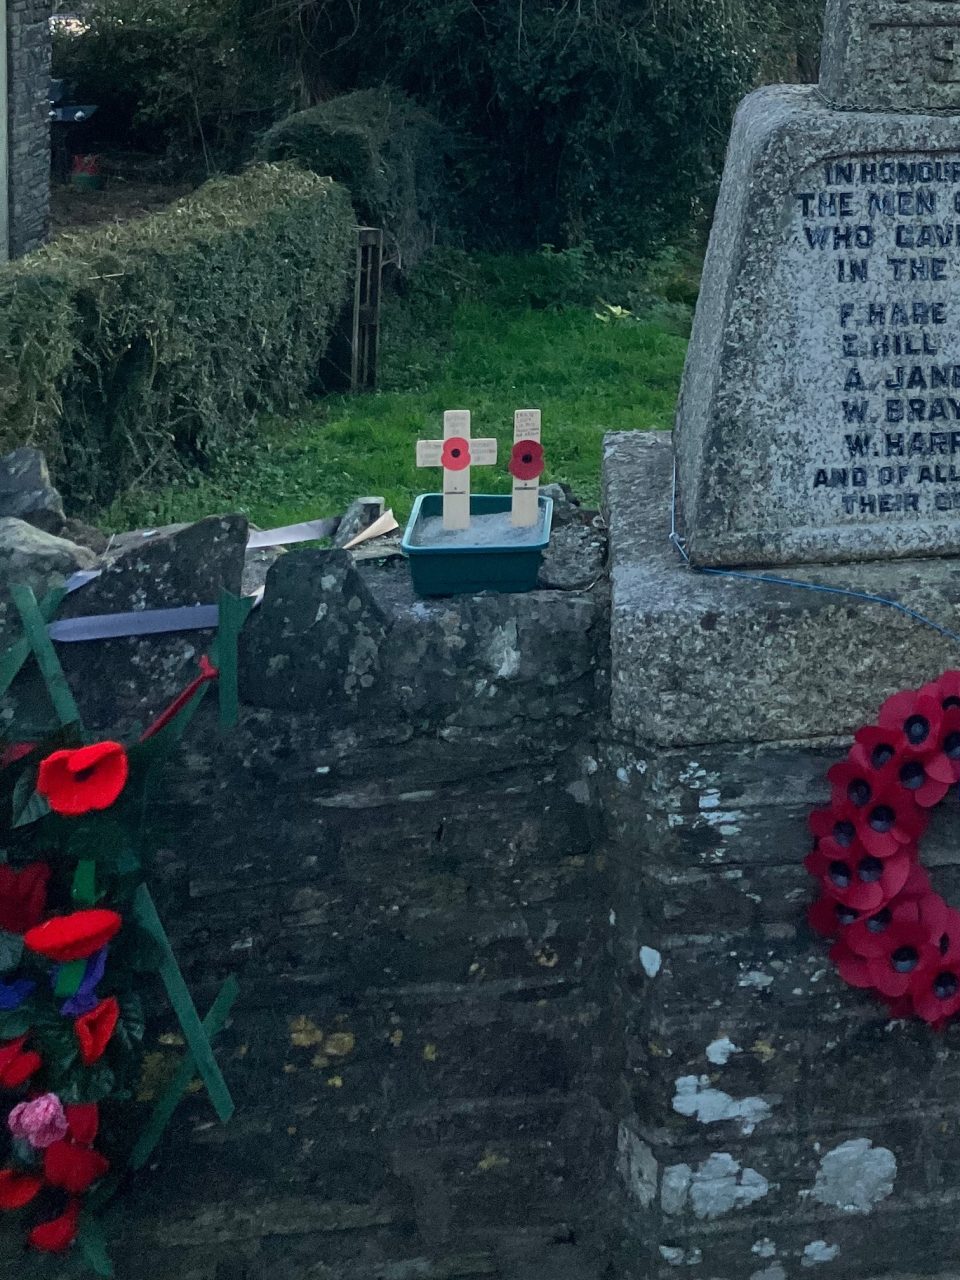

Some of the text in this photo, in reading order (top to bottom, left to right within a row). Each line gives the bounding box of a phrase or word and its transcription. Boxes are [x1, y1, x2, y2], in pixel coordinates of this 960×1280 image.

[825, 162, 853, 185] IN
[793, 192, 853, 217] THE
[868, 191, 936, 217] MEN
[804, 225, 875, 250] WHO
[838, 258, 868, 283] IN
[887, 257, 947, 281] THE
[869, 302, 947, 326] HARE
[871, 332, 937, 357] HILL
[813, 468, 867, 487] AND
[879, 465, 909, 485] OF
[842, 493, 919, 514] THEIR
